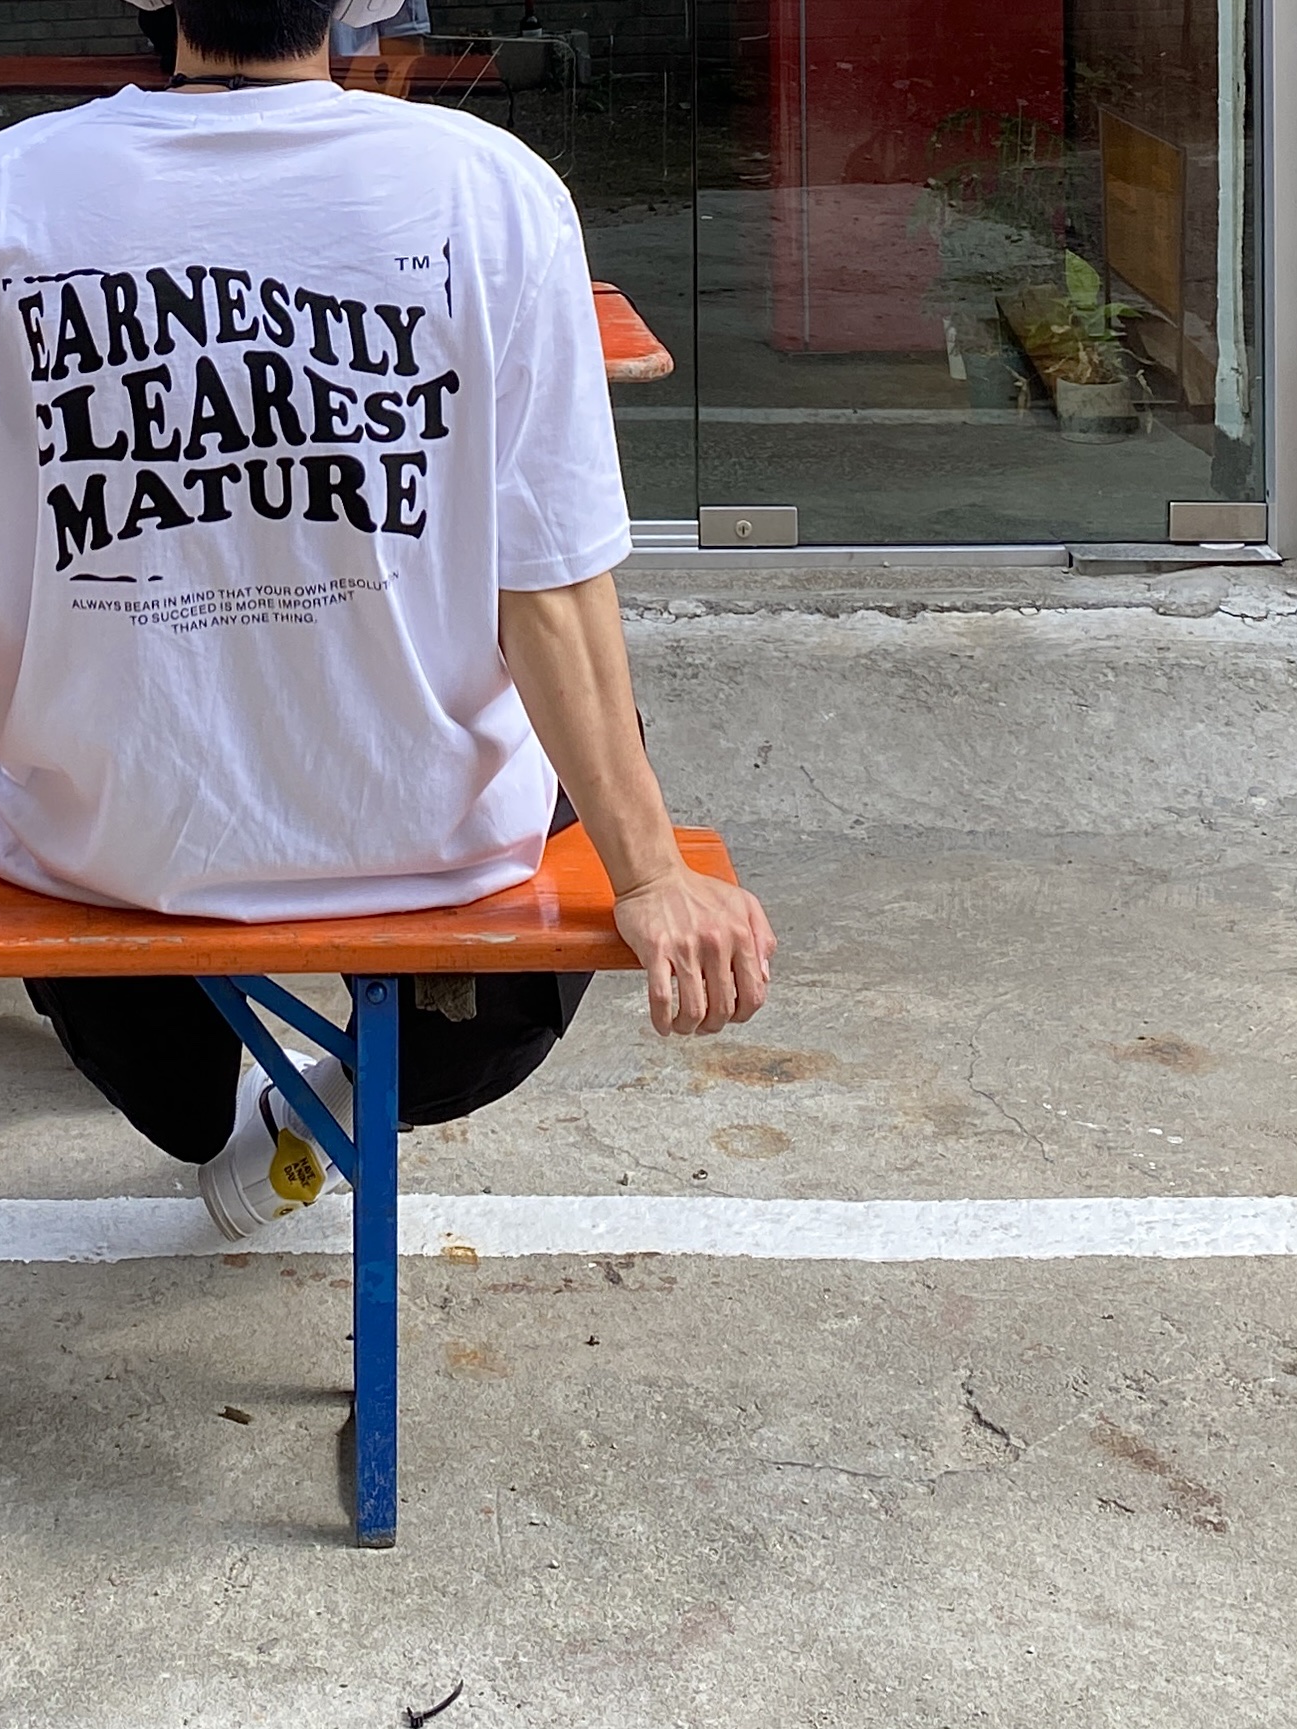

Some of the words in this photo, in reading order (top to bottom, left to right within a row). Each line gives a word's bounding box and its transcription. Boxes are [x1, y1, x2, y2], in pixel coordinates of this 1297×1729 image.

[395, 255, 431, 270] TM
[19, 265, 426, 382] EARNESTLY
[47, 451, 428, 572] MATURE
[72, 599, 121, 611] ALWAYS
[124, 599, 160, 612] BEAR
[163, 597, 177, 608] IN
[180, 590, 215, 605] MIND
[218, 587, 252, 599] THAT
[256, 585, 291, 596] YOUR
[294, 583, 327, 597] OWN
[130, 614, 148, 626] TO
[152, 602, 217, 623] SUCCEED
[220, 601, 233, 612] IS
[236, 598, 274, 611] MORE
[278, 590, 355, 610] IMPORTANT
[171, 619, 208, 635] THAN
[211, 615, 238, 627] ANY
[241, 612, 269, 625] ONE
